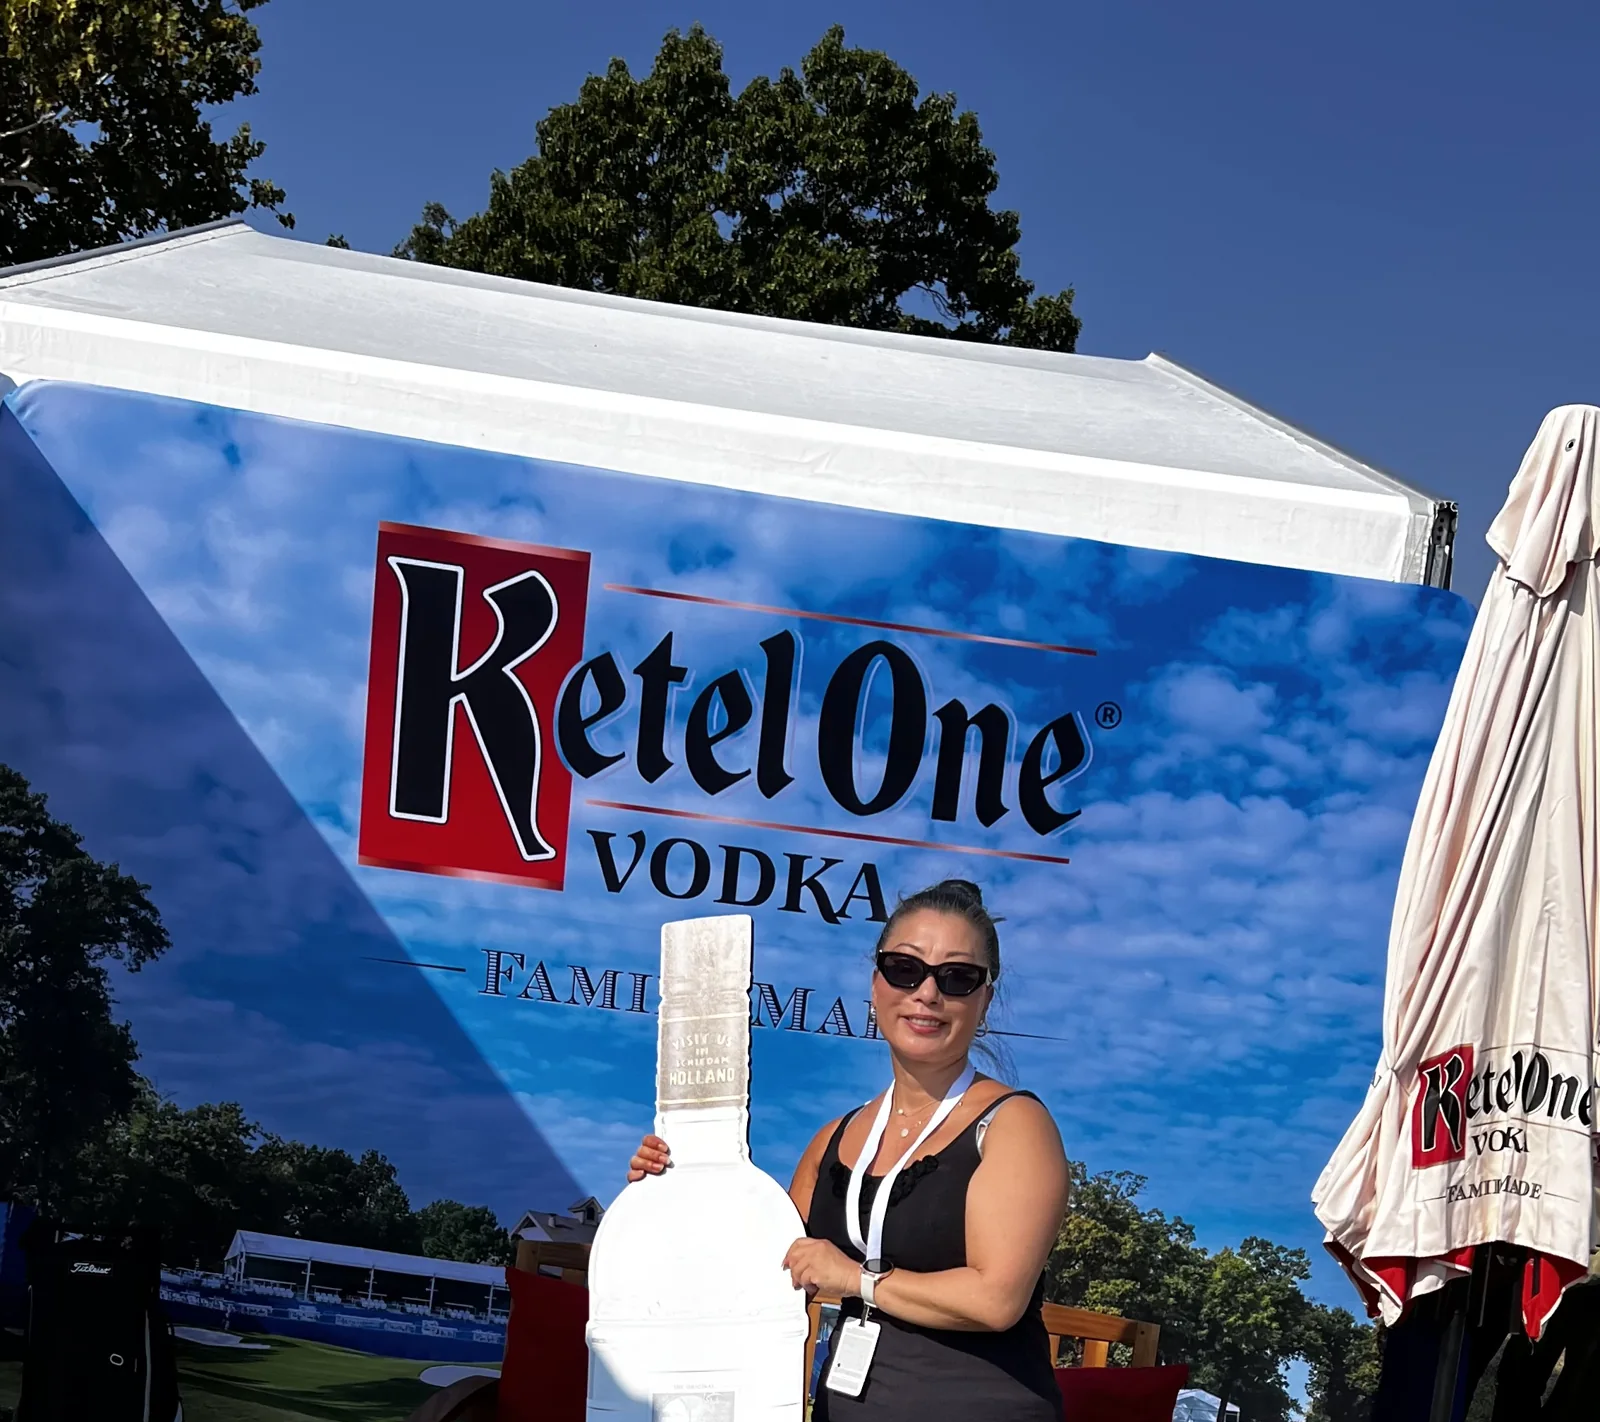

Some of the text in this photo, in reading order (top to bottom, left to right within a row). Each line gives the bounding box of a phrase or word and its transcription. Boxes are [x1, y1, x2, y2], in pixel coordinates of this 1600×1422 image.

[388, 556, 800, 862] Ketel
[587, 829, 888, 925] VODKA
[478, 948, 886, 1040] FAMI MA
[669, 1067, 735, 1086] HOLLAND
[671, 1032, 732, 1050] VISIT US
[676, 1056, 729, 1068] SCHIEDAM
[1422, 1051, 1523, 1153] Ketel
